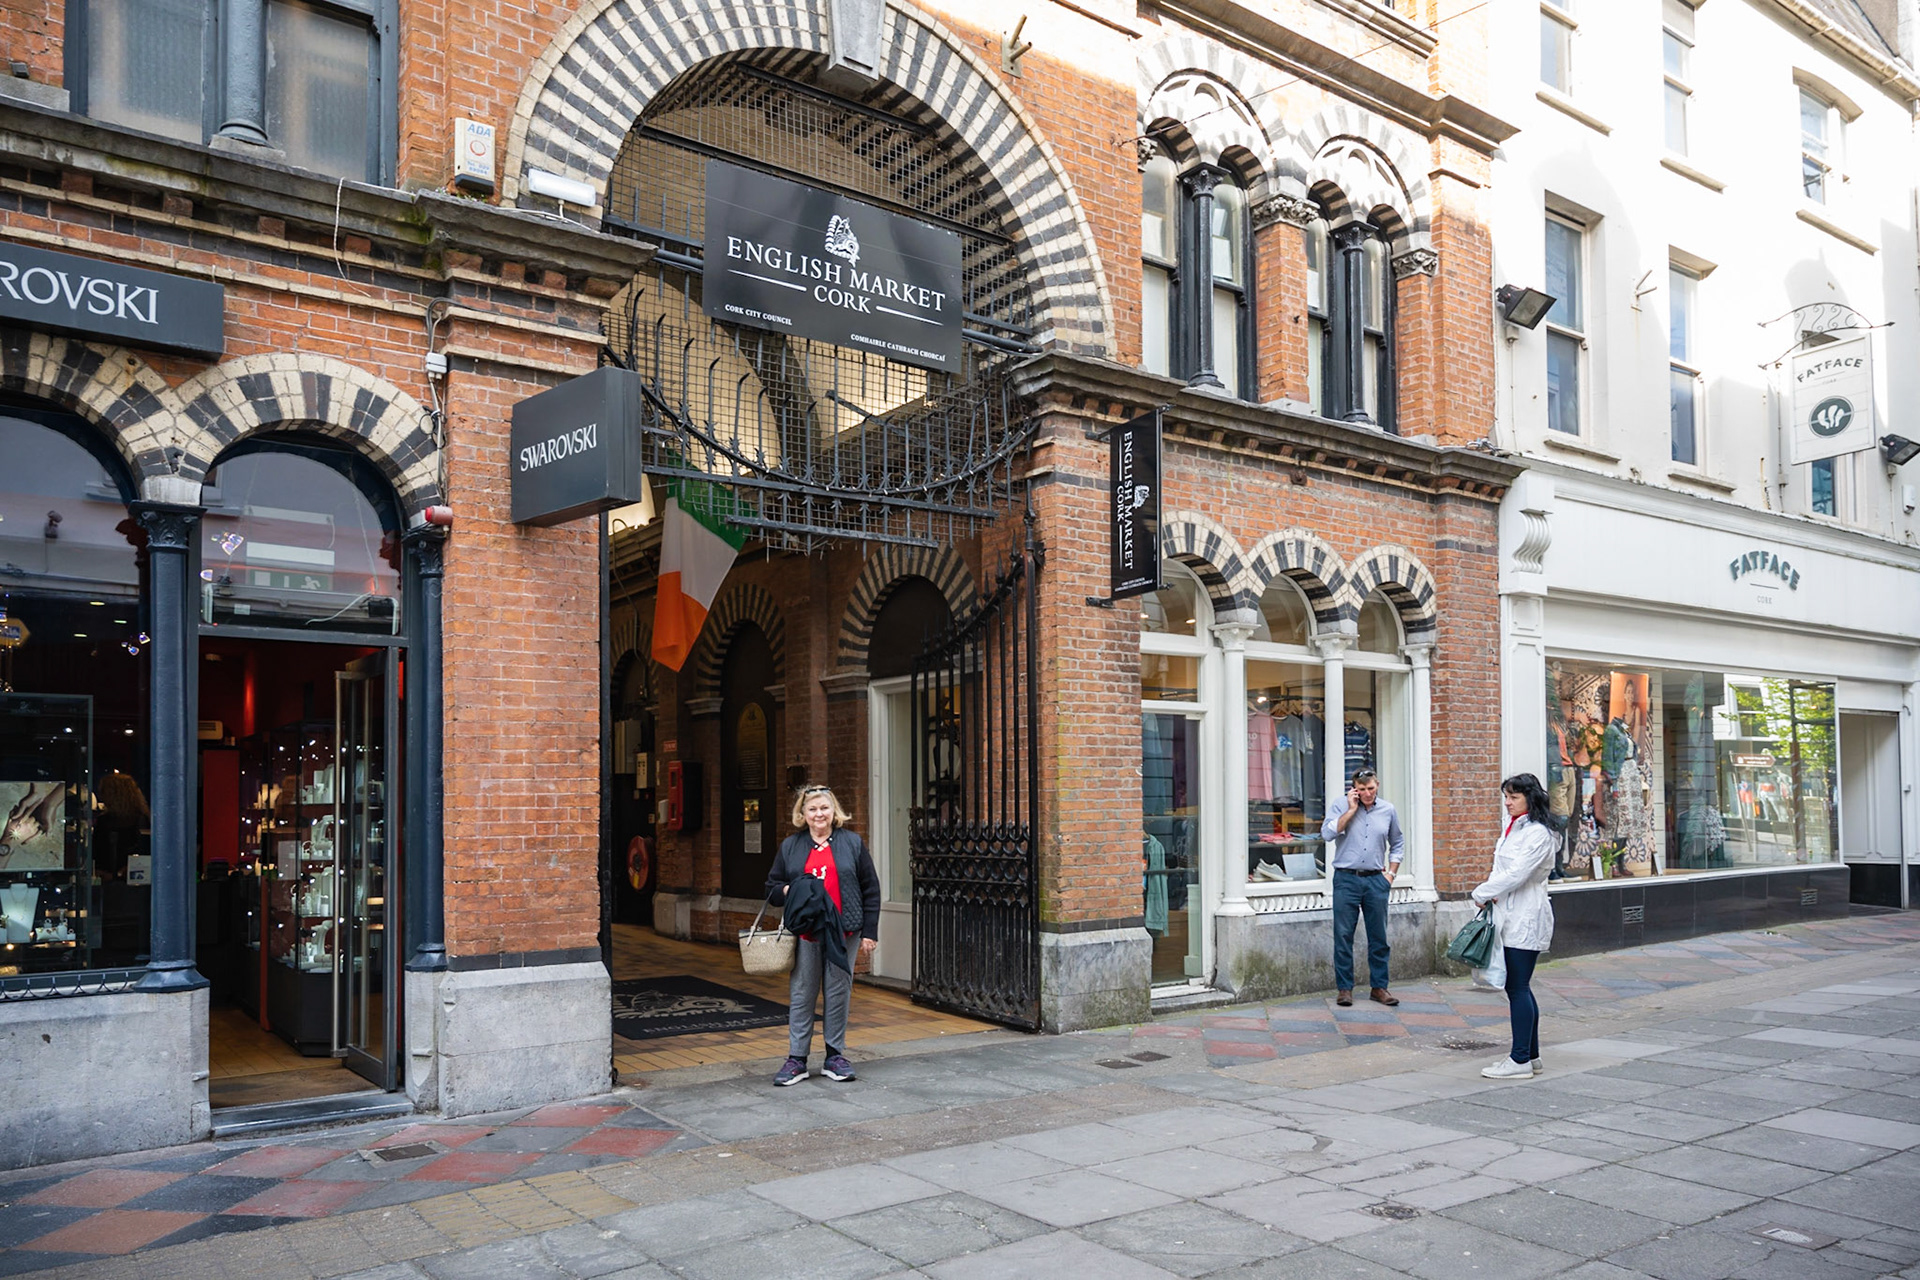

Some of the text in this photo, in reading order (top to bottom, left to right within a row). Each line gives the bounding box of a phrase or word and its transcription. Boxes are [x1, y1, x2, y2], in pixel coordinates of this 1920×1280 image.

[467, 123, 491, 137] ADA
[727, 236, 946, 311] ENGLISH MARKET
[725, 304, 793, 326] CORK CITY COUNCIL
[813, 285, 871, 314] CORK
[850, 333, 946, 362] COMHAIRLE CATHRACH CHORCAÍ
[1797, 358, 1863, 382] FATFACE
[520, 423, 597, 472] SWAROVSKI
[1116, 485, 1124, 522] CORK
[1124, 431, 1133, 570] ENGLISH MARKET
[1729, 550, 1801, 591] FATFACE
